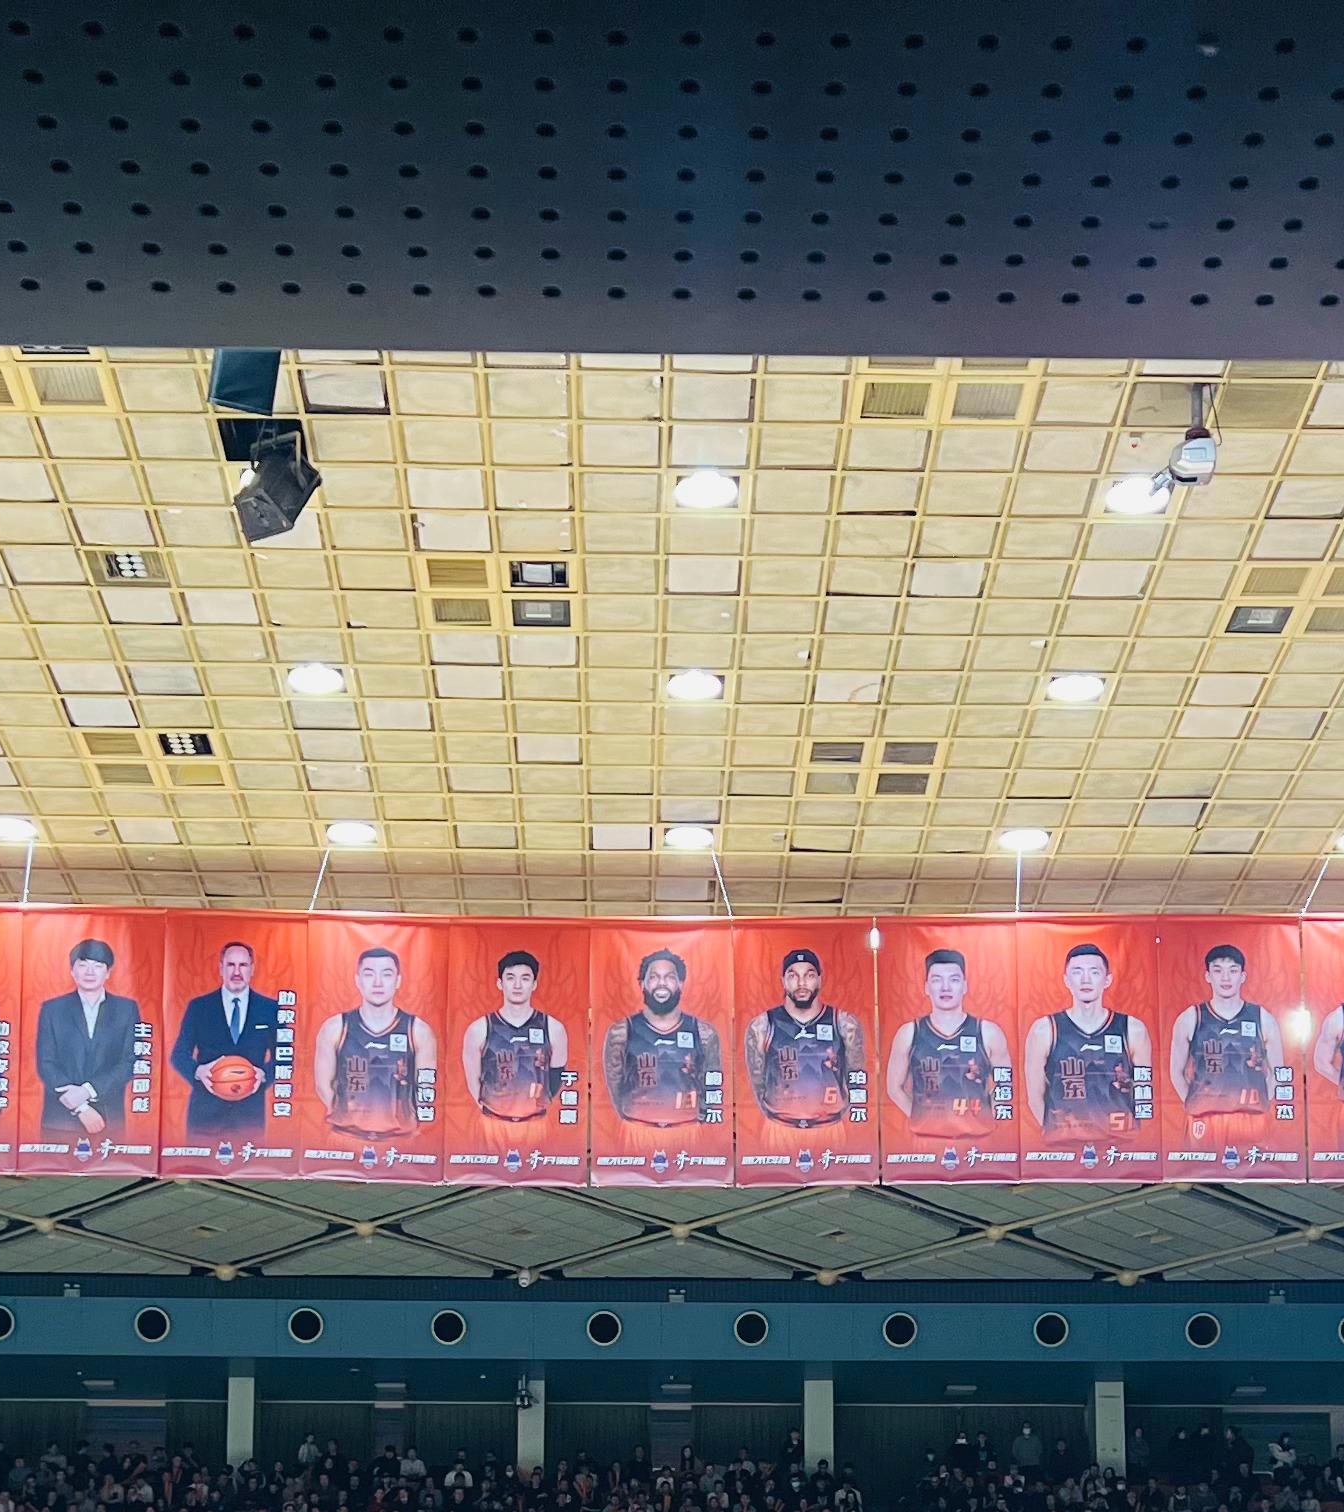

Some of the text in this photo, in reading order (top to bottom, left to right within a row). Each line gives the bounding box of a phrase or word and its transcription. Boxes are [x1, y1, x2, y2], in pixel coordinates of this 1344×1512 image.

[347, 1055, 368, 1092] 山东
[496, 1048, 516, 1081] 山东
[636, 1051, 657, 1087] 山东
[778, 1047, 799, 1082] 山东
[920, 1056, 940, 1092] 山东
[1203, 1038, 1224, 1074] 山东
[993, 1066, 1013, 1120] 陈培东
[1060, 1057, 1088, 1099] 山东
[1133, 1066, 1153, 1119] 陈林坚
[952, 1098, 981, 1116] 44
